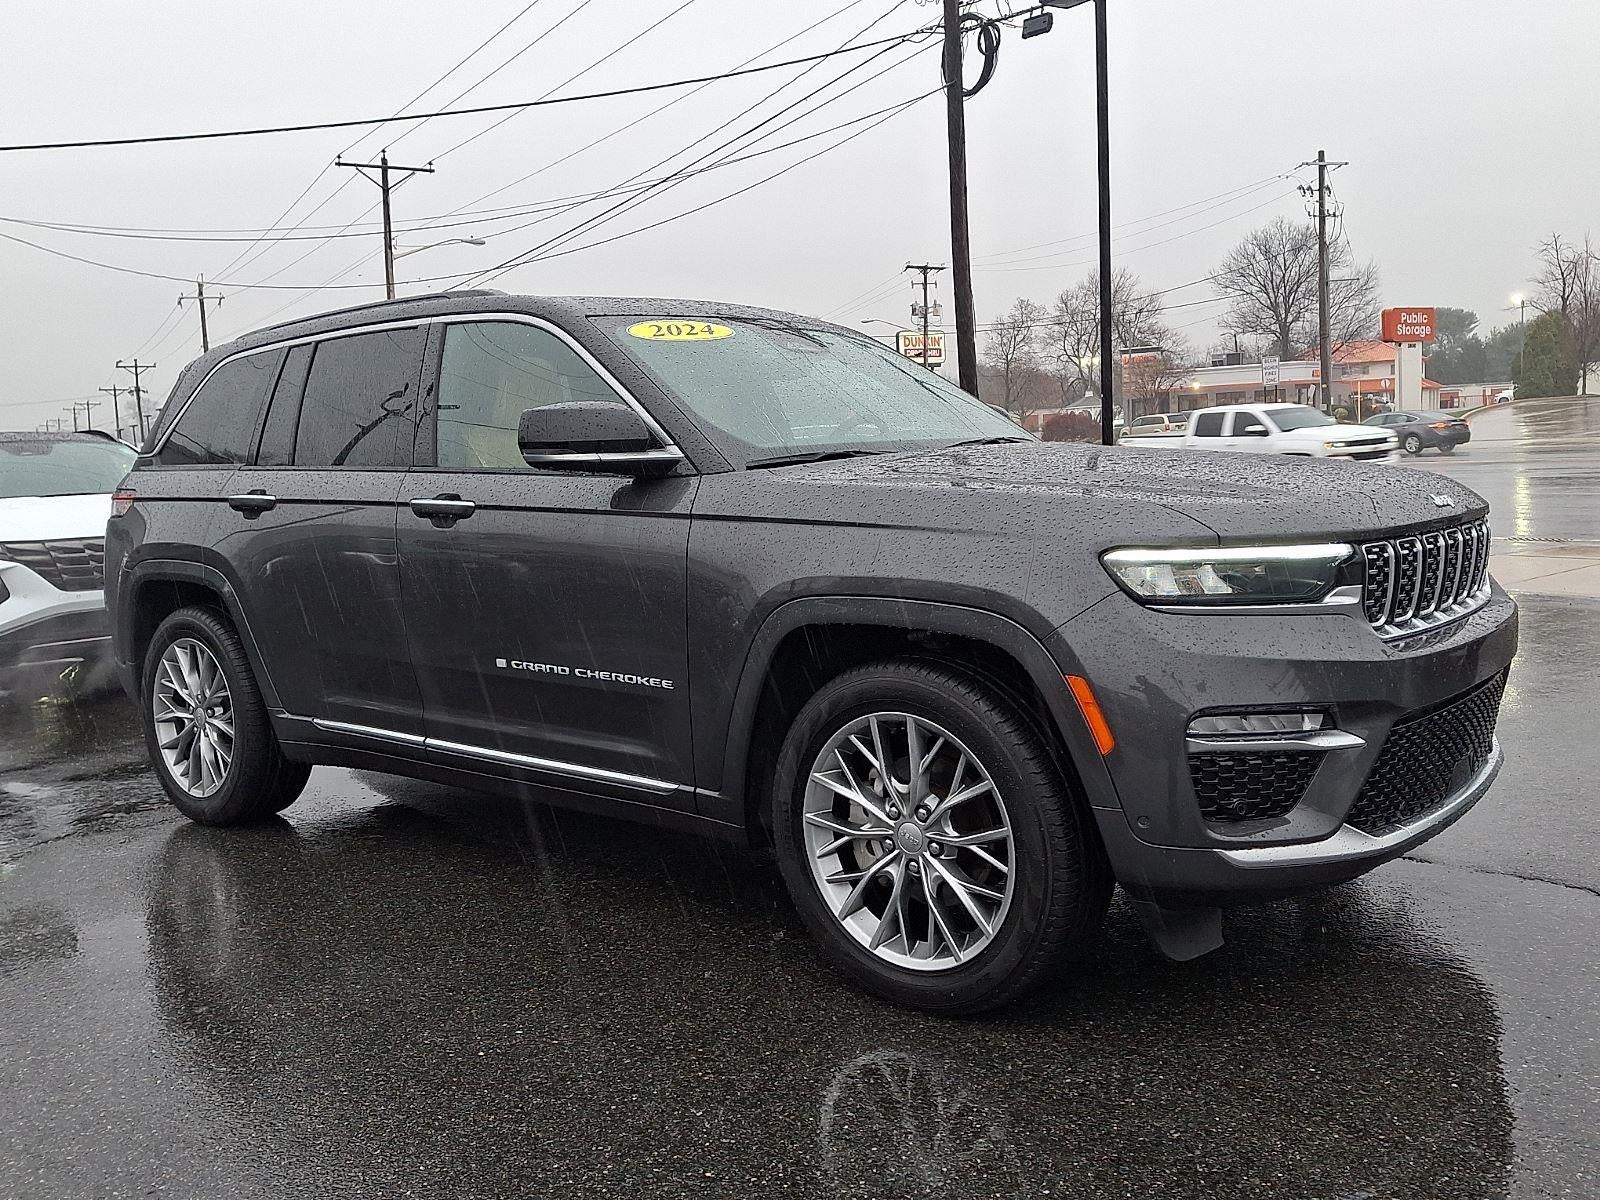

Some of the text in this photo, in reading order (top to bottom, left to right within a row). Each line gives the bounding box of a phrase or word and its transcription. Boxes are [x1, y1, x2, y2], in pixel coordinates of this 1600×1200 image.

[1401, 312, 1428, 323] Public
[648, 323, 715, 337] 2024
[1397, 324, 1431, 337] Storage
[511, 660, 675, 690] GRAND CHEROKEE
